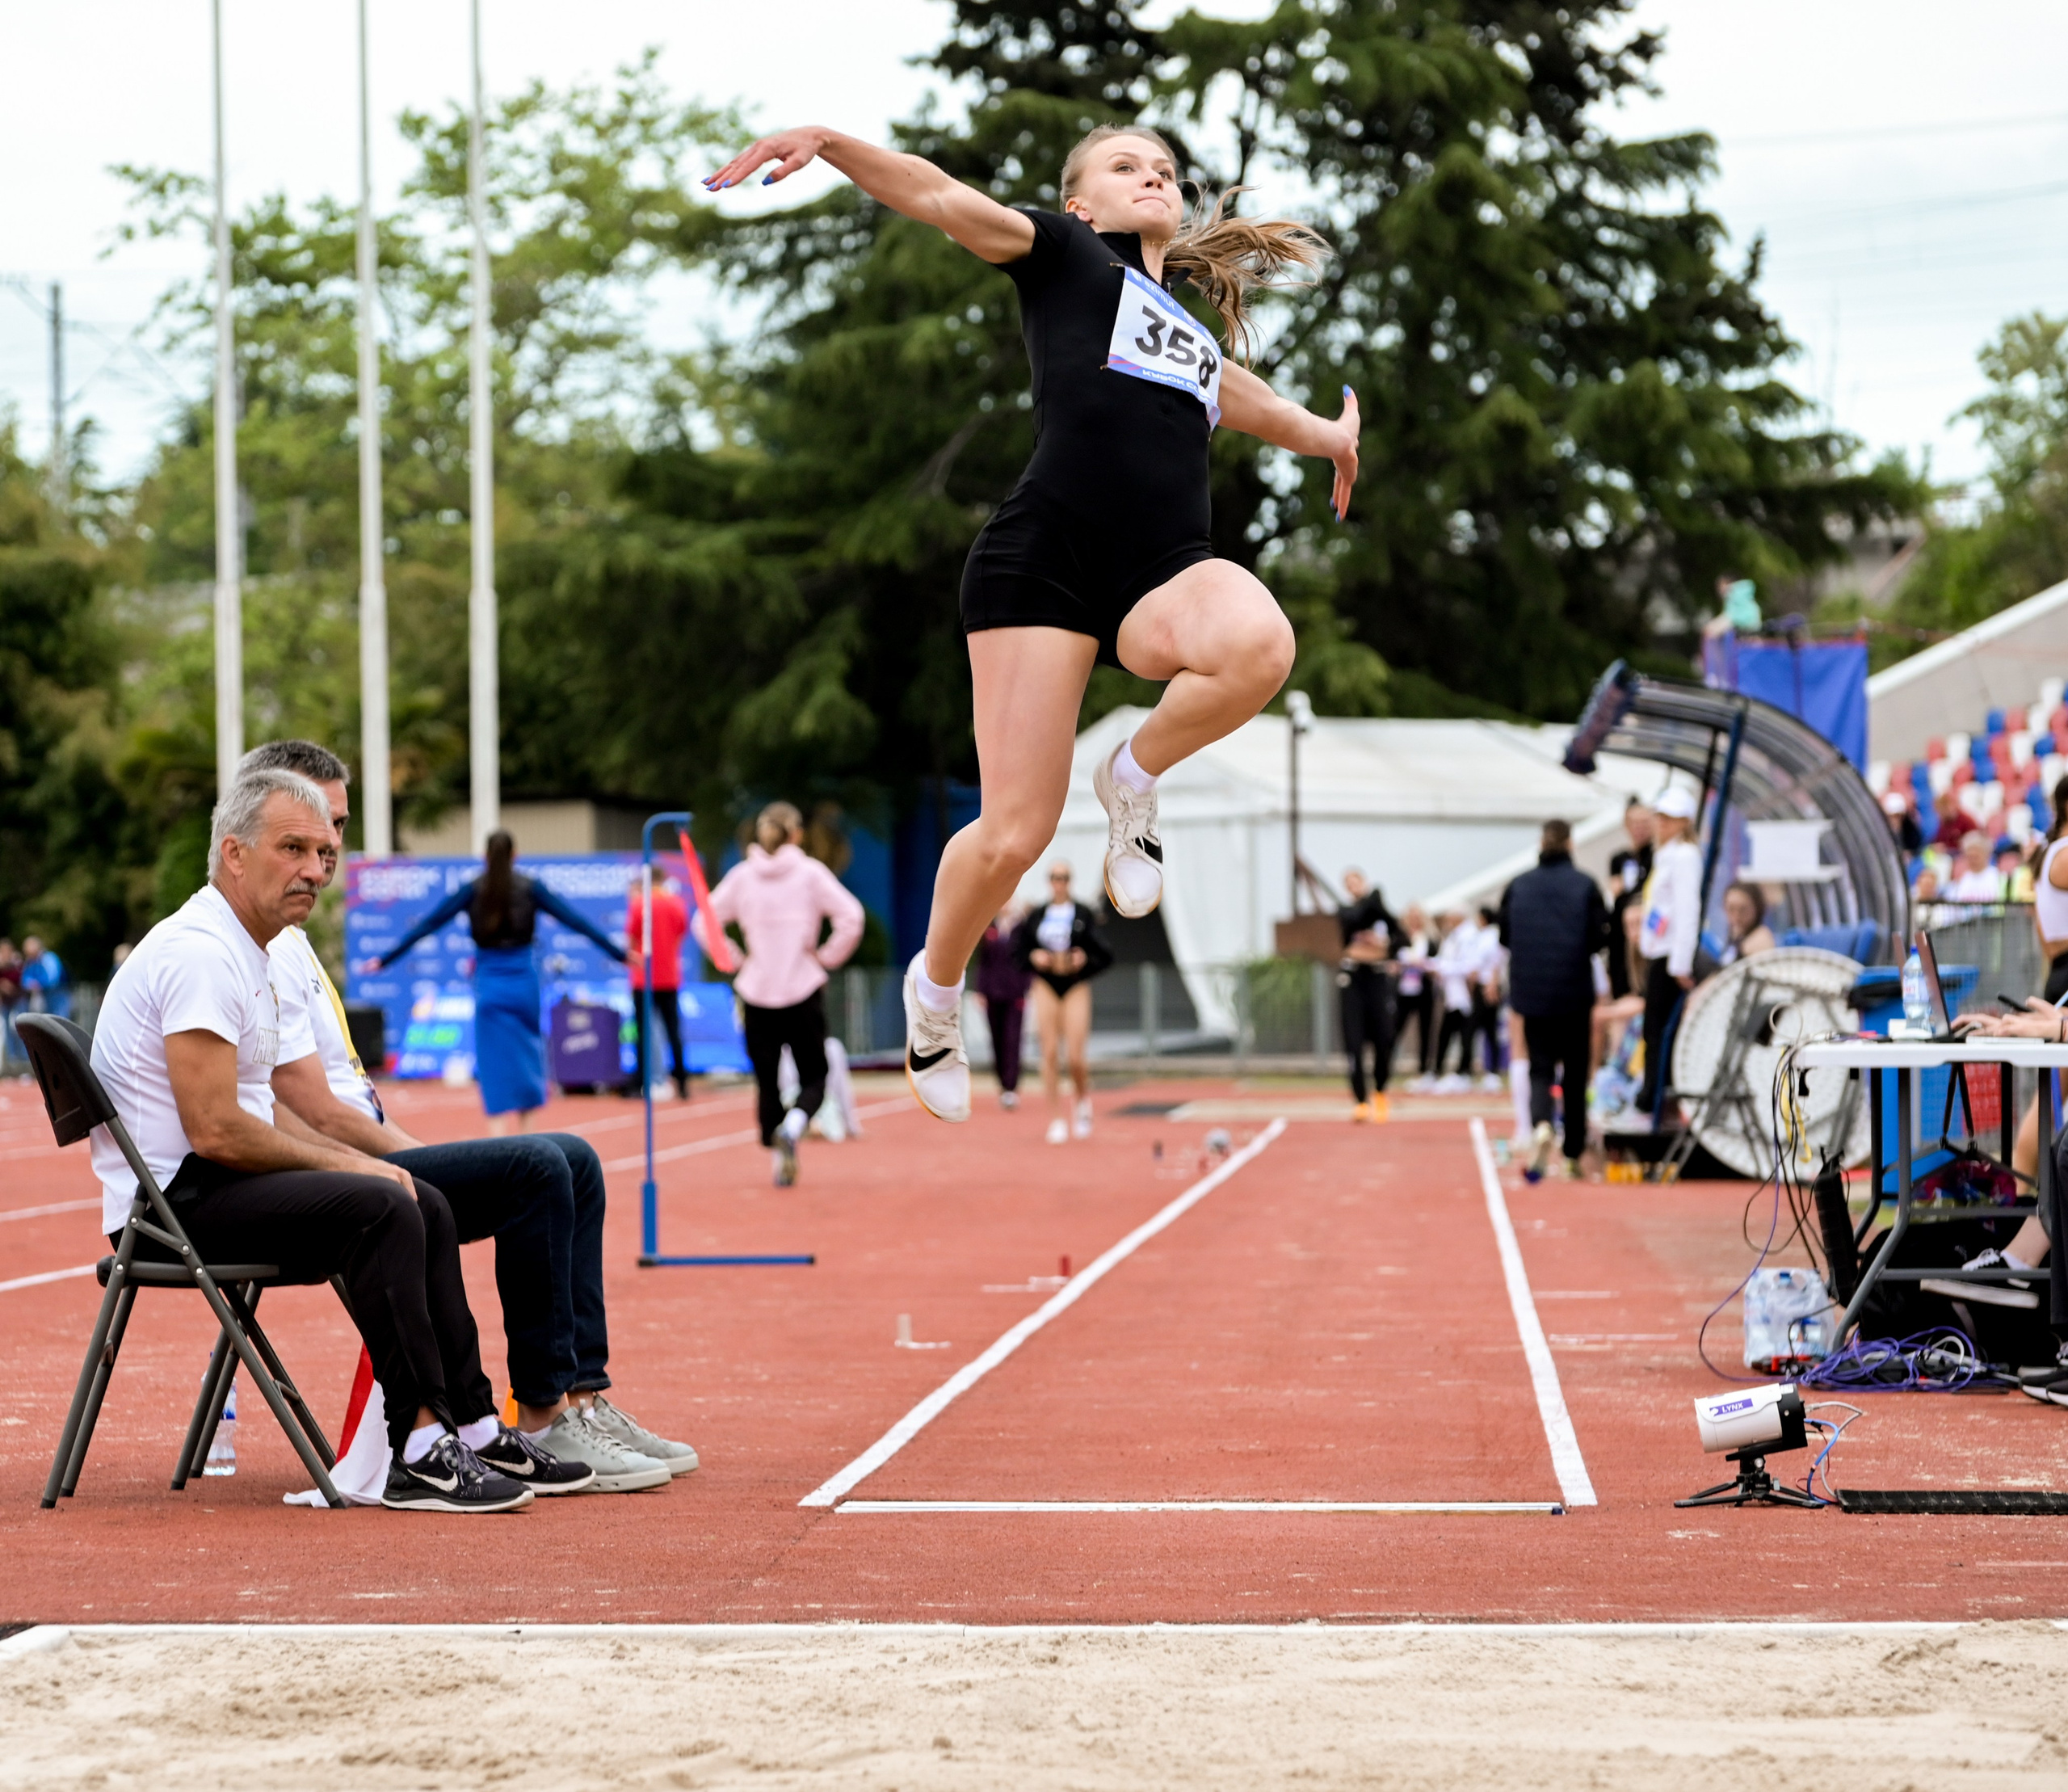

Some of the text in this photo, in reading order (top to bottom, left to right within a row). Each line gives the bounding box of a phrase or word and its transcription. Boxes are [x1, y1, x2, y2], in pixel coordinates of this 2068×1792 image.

[1144, 280, 1175, 311] azimut
[1134, 304, 1217, 389] 358
[1142, 368, 1185, 386] КУБОК
[1721, 1402, 1744, 1413] LYNX
